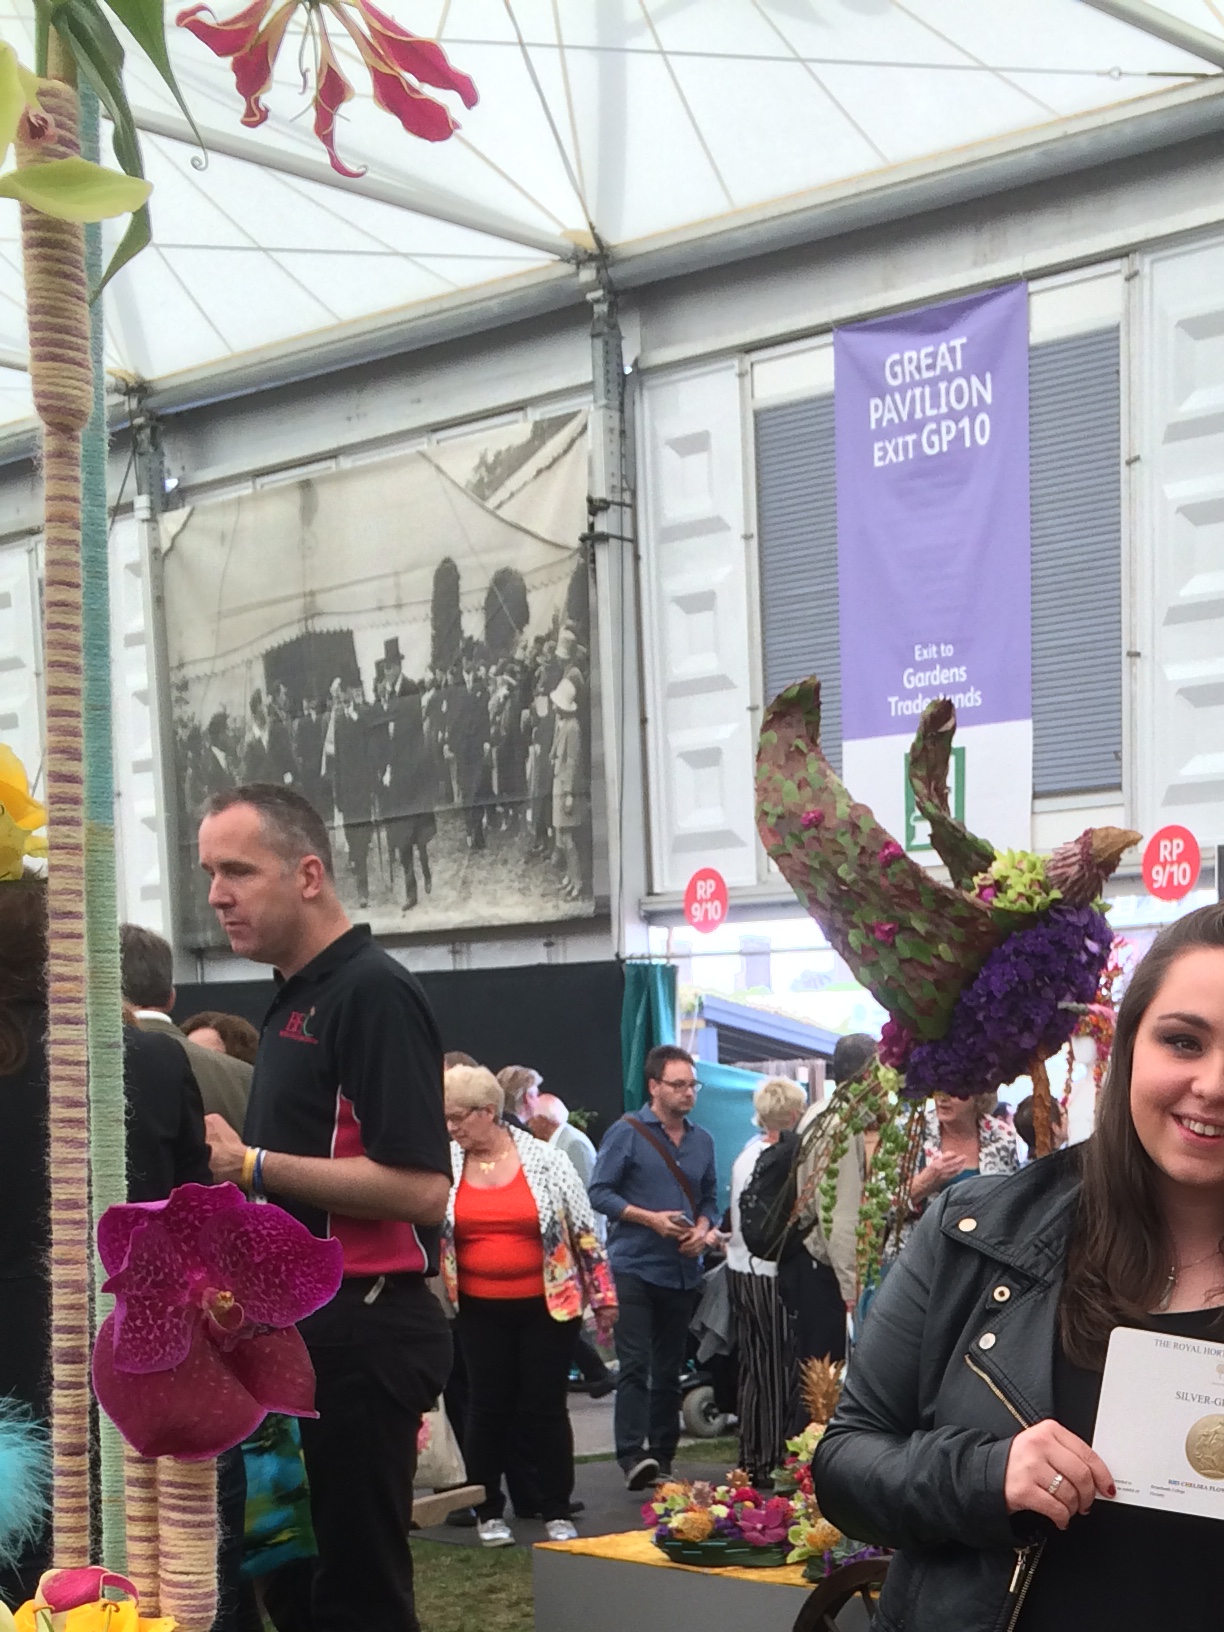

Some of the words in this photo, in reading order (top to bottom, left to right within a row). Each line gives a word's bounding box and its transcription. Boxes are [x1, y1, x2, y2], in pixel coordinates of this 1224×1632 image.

[885, 336, 967, 387] GREAT
[869, 371, 993, 430] PAVILION
[873, 433, 917, 468] EXIT
[921, 411, 991, 456] GP10
[914, 643, 938, 661] Exit
[940, 642, 954, 657] to
[903, 663, 967, 689] Gardens
[1159, 838, 1184, 863] RP
[1151, 861, 1191, 889] 9/10
[696, 878, 716, 901] RP
[691, 899, 722, 923] 9/10
[1154, 1338, 1171, 1349] THE
[1173, 1341, 1202, 1355] ROYAL
